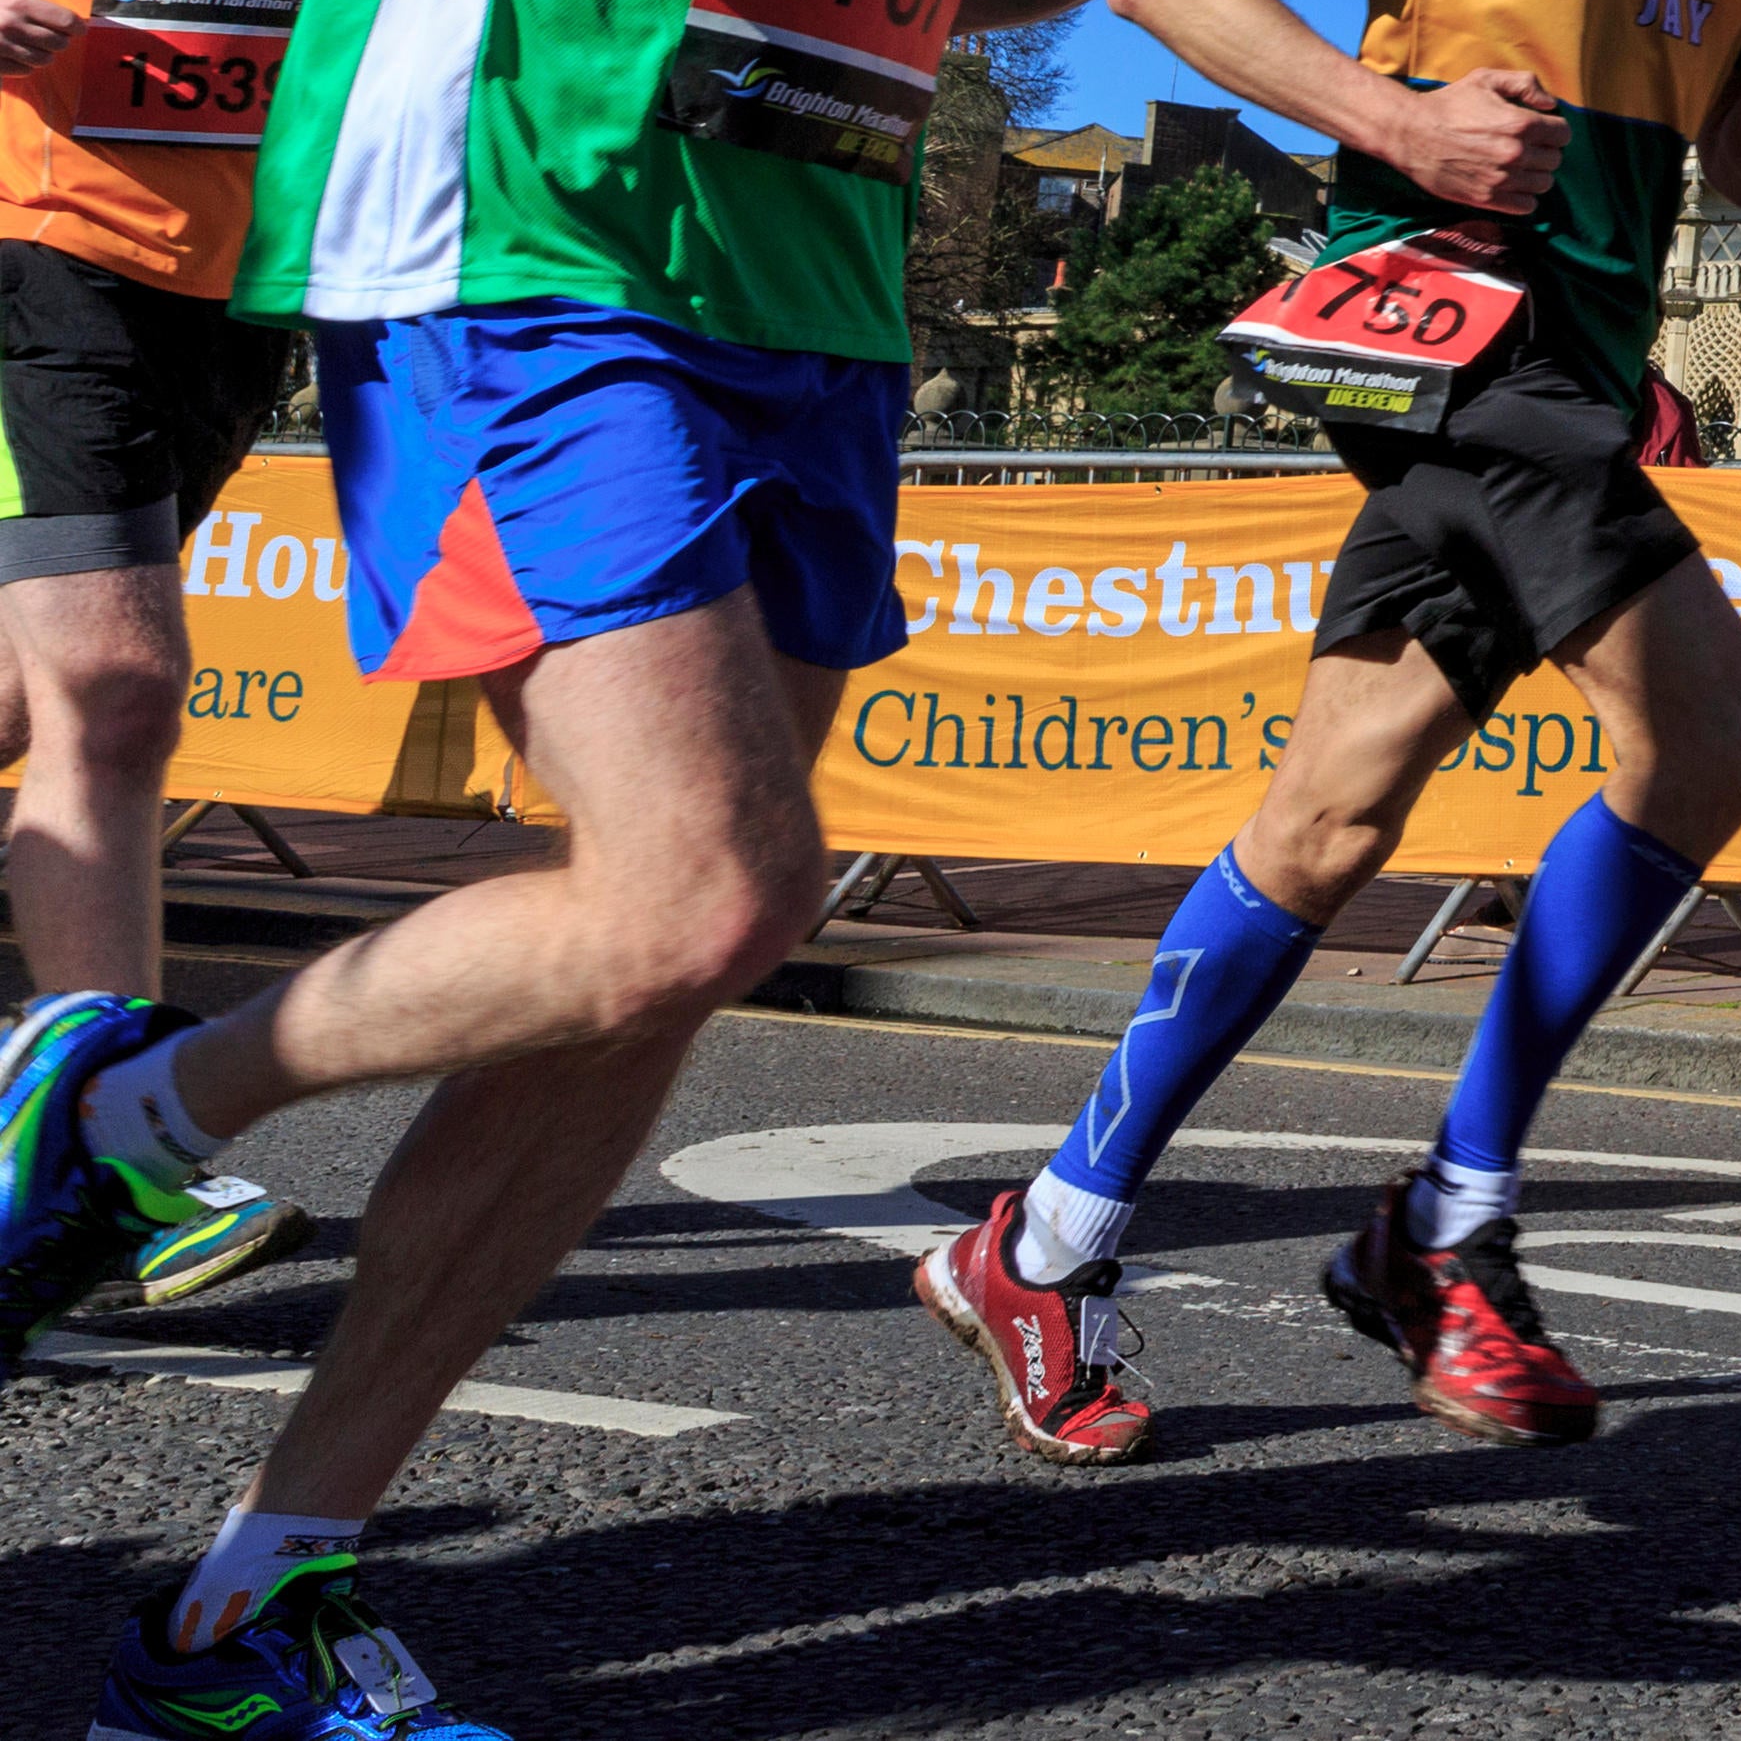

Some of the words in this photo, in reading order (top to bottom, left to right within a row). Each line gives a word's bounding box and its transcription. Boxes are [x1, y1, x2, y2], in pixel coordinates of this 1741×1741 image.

[765, 80, 849, 120] Brighton
[1325, 388, 1414, 414] WEEKEND
[1333, 365, 1422, 393] Marathon
[183, 510, 350, 603] Hou
[894, 539, 1334, 638] Chestnu
[187, 667, 304, 723] are
